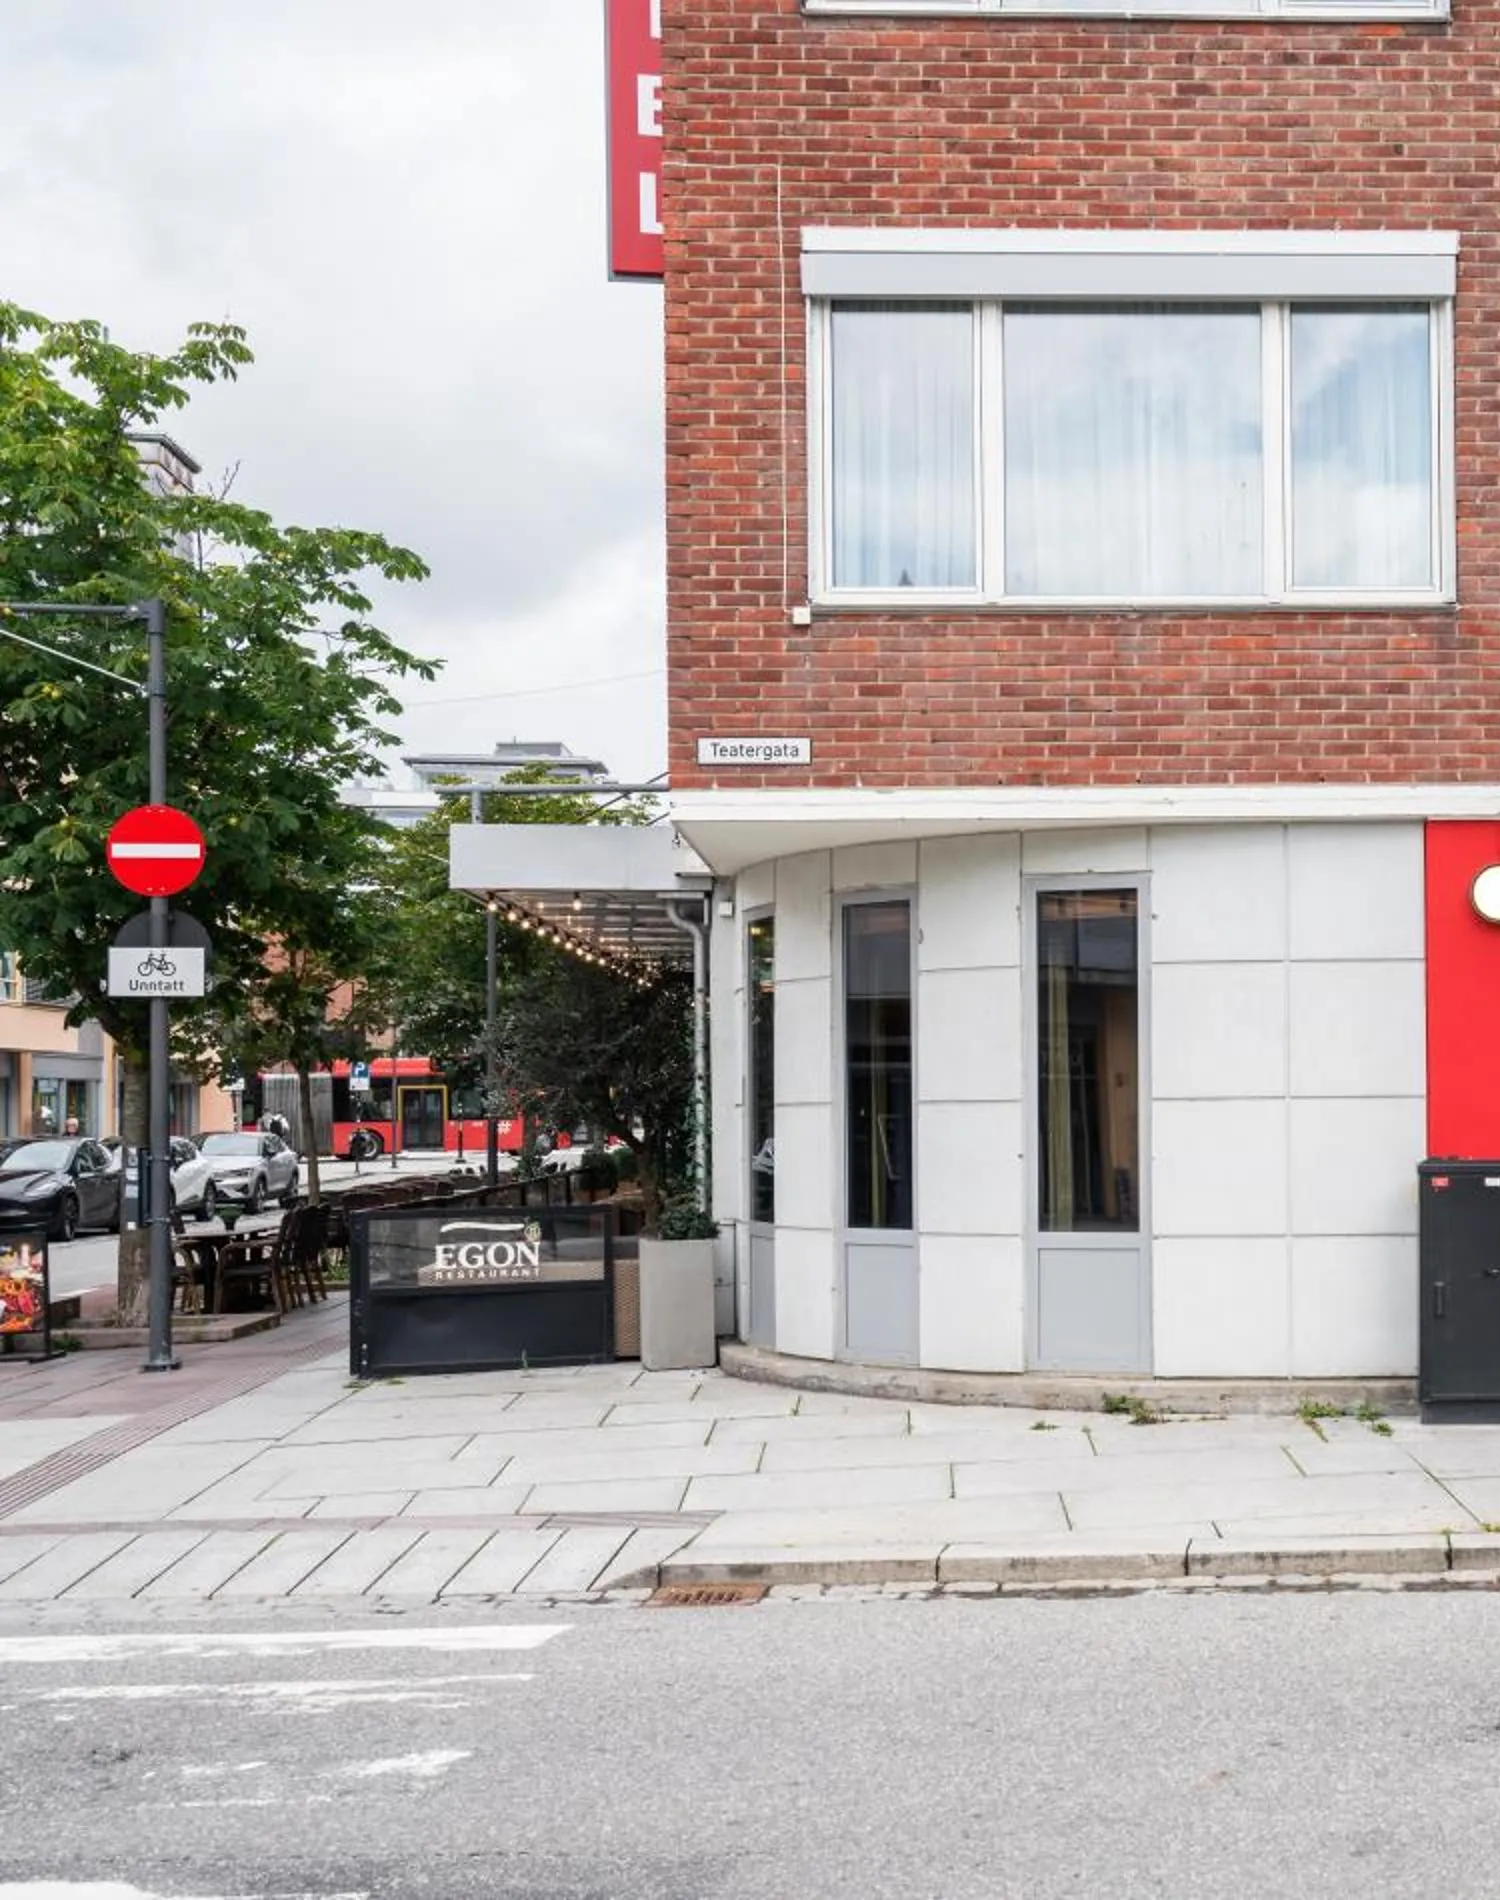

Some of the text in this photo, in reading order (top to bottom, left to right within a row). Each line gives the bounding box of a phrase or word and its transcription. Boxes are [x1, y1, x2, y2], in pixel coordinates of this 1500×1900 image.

[710, 742, 799, 760] Teatergata
[129, 979, 184, 991] Unntatt
[435, 1241, 541, 1269] EGON
[435, 1267, 540, 1280] RESTAURANT
